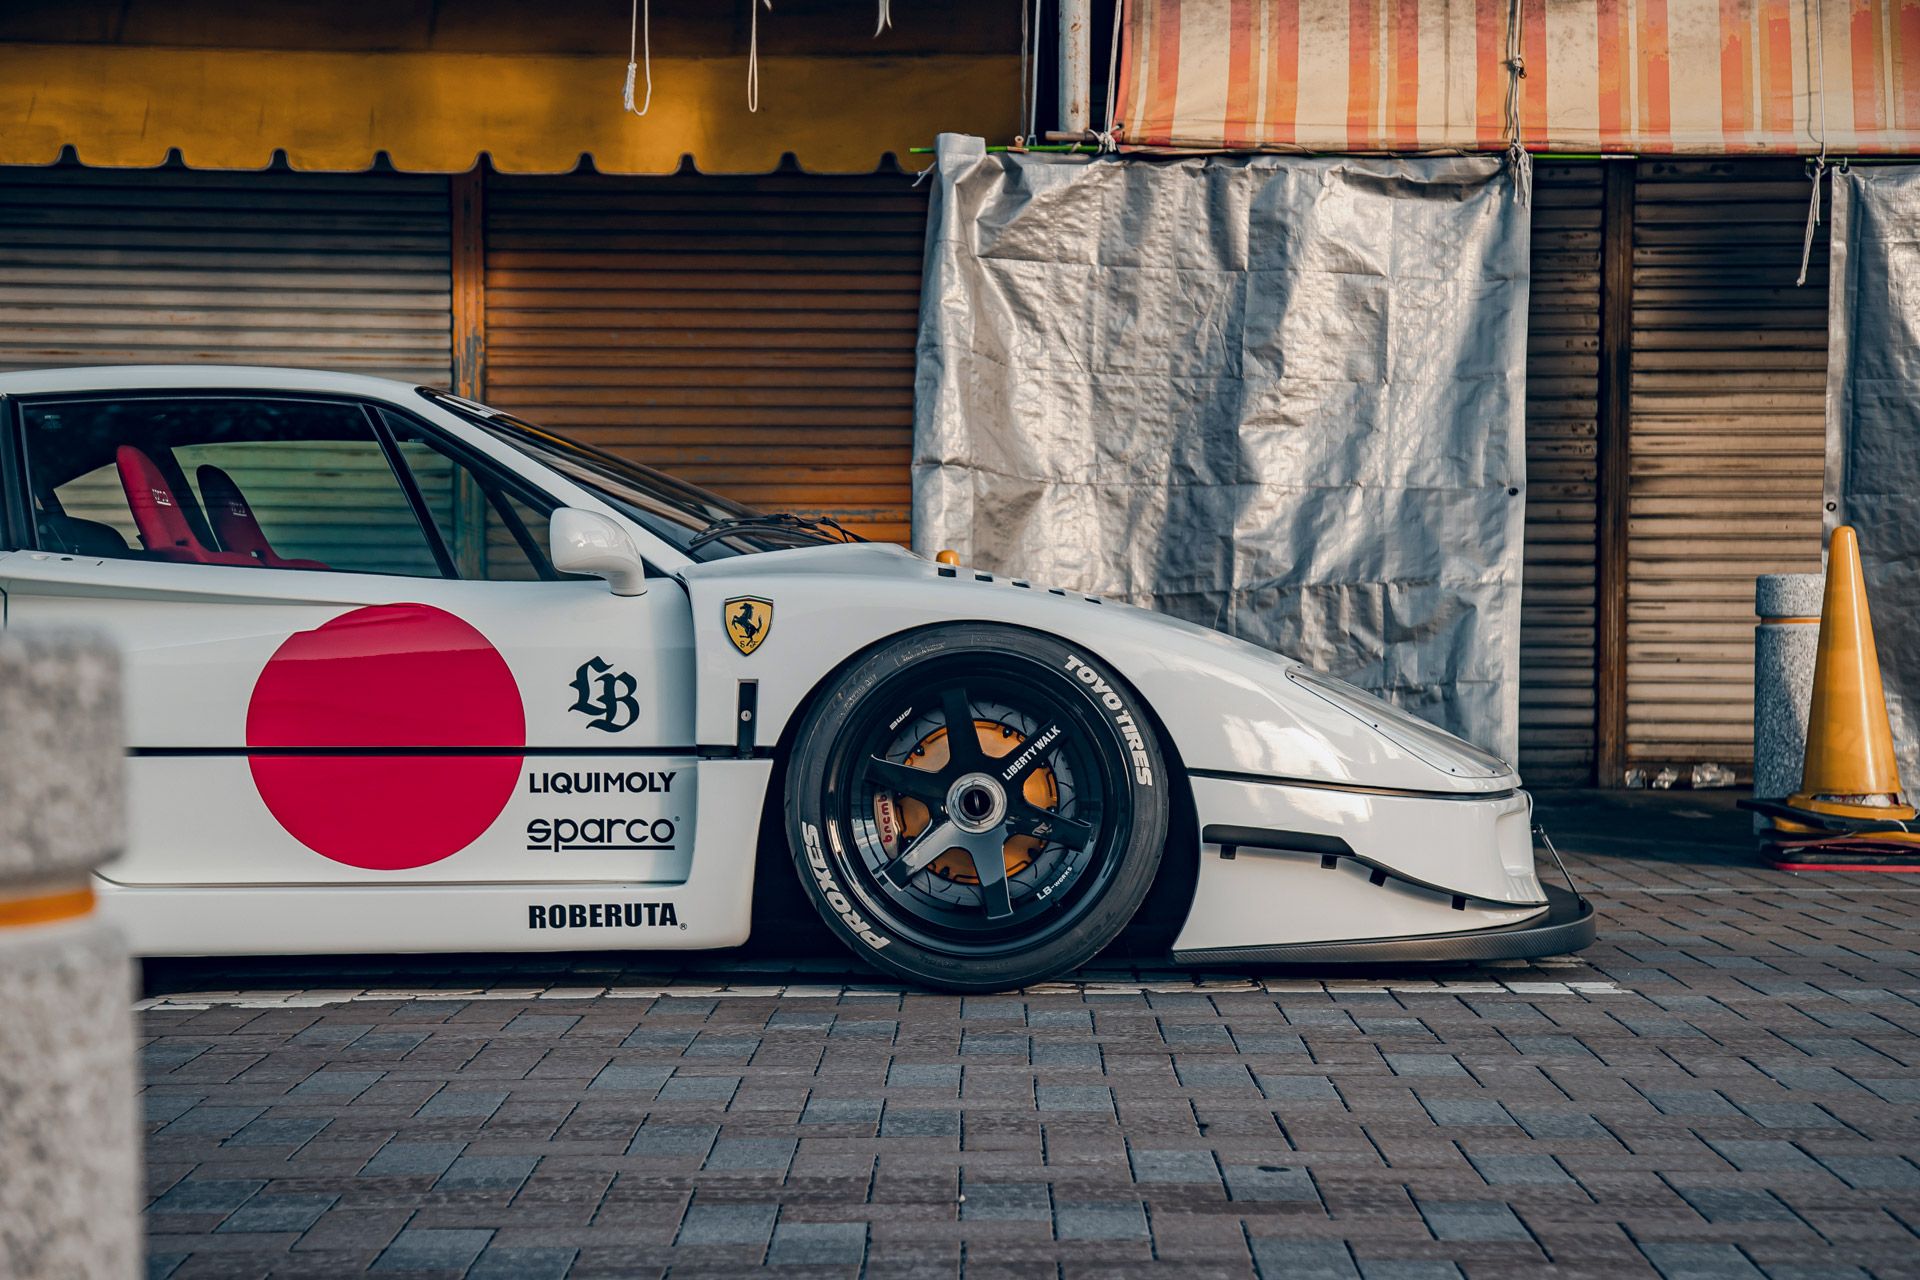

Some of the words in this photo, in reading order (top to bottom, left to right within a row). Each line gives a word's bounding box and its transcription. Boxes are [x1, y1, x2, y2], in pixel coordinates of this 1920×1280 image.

[568, 656, 639, 732] LB
[1064, 654, 1123, 711] TOYO
[1115, 709, 1153, 787] TIRES
[1002, 746, 1037, 780] LIBERTY
[1034, 725, 1061, 750] WALK
[877, 794, 893, 843] bremb
[801, 821, 891, 950] PROXES
